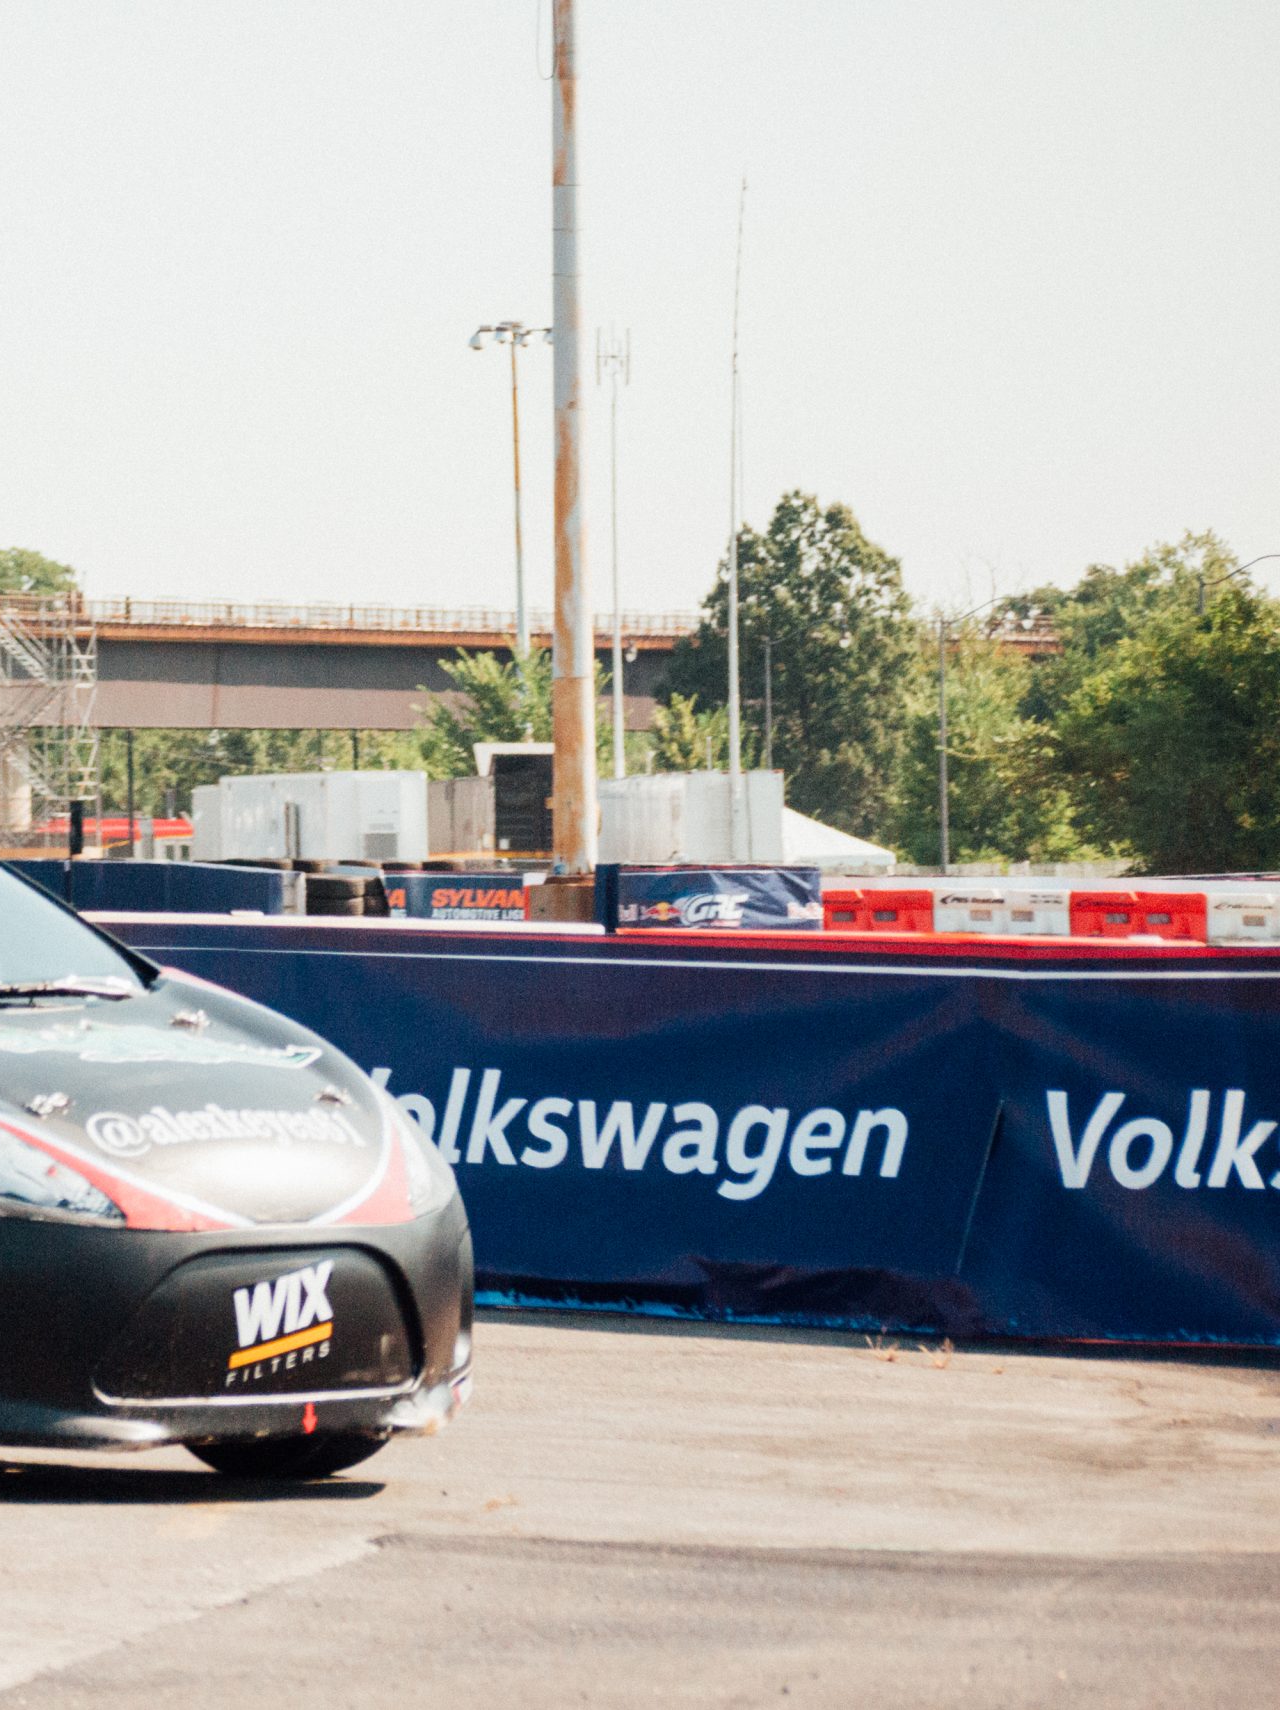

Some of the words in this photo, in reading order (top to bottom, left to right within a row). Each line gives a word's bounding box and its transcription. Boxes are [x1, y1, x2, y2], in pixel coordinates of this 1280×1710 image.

[370, 1067, 909, 1200] lkswagen
[1046, 1089, 1280, 1190] Volk
[233, 1259, 335, 1349] WIX
[225, 1340, 332, 1388] FILTERS
